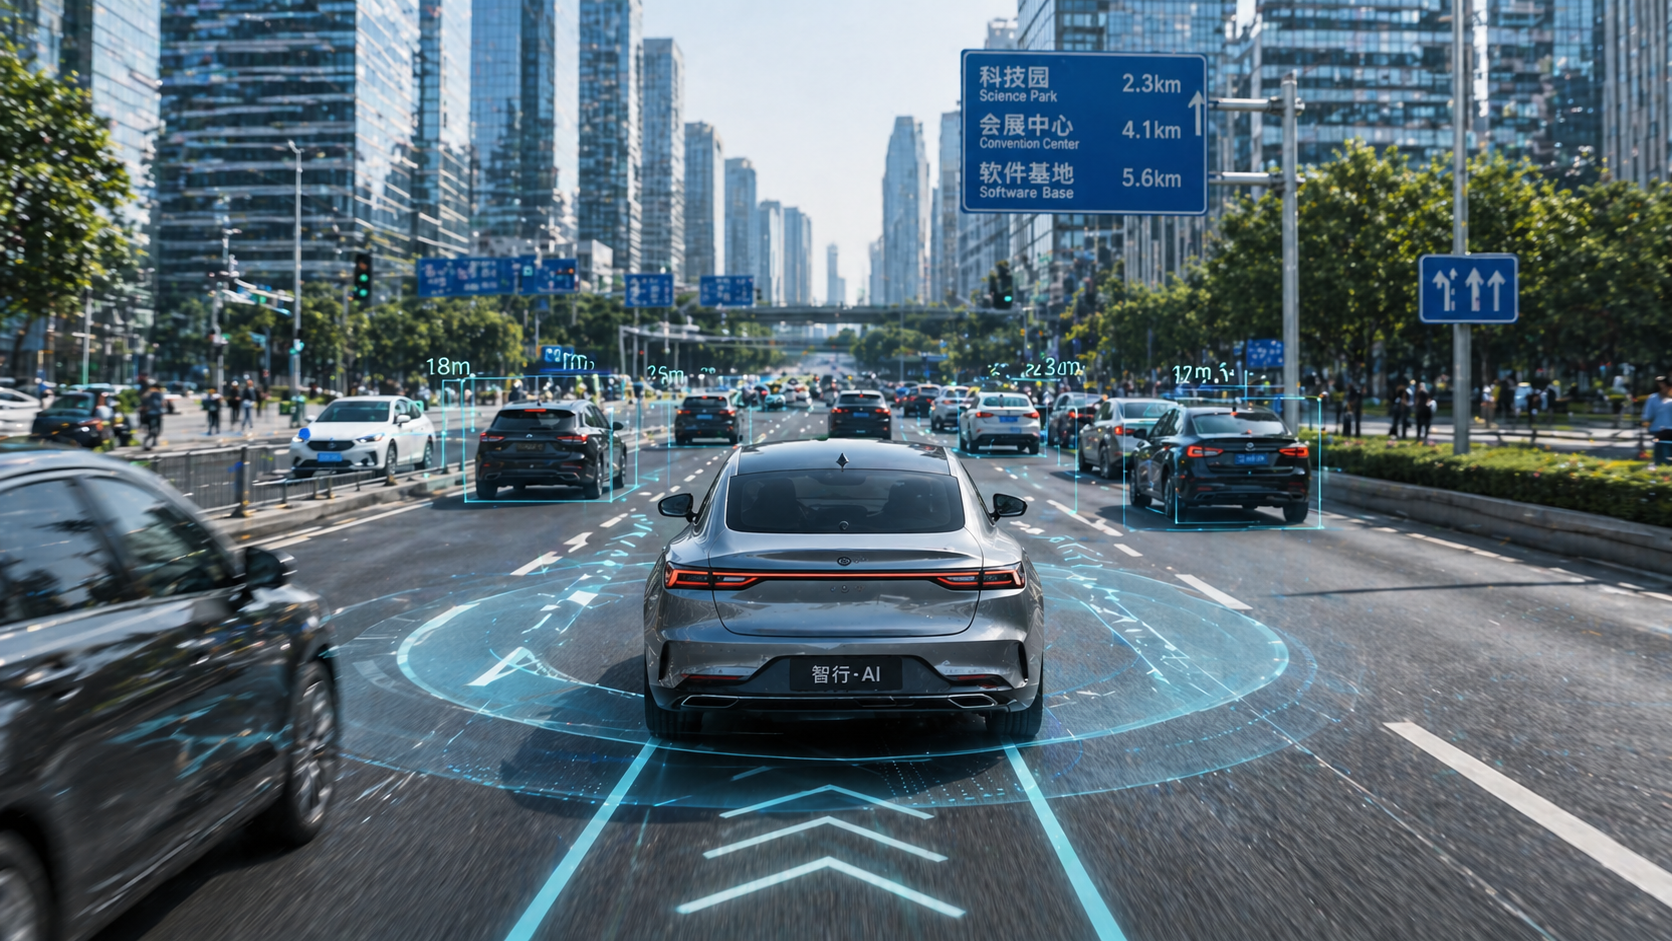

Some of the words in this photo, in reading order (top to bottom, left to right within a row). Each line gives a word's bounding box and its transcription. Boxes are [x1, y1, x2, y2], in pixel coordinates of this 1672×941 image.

[979, 65, 1049, 89] 科技园
[1122, 73, 1181, 93] 2.3km
[979, 89, 1027, 102] Science
[1030, 89, 1057, 102] Park
[979, 113, 1074, 137] 会展中心
[1122, 120, 1181, 139] 4.1km
[979, 137, 1040, 149] Convention
[1043, 138, 1080, 150] Center
[979, 161, 1074, 185] 软件基地
[1122, 168, 1181, 188] 5.6km
[979, 186, 1037, 199] Software
[1042, 187, 1074, 199] Base
[811, 664, 880, 684] 智行·AI
